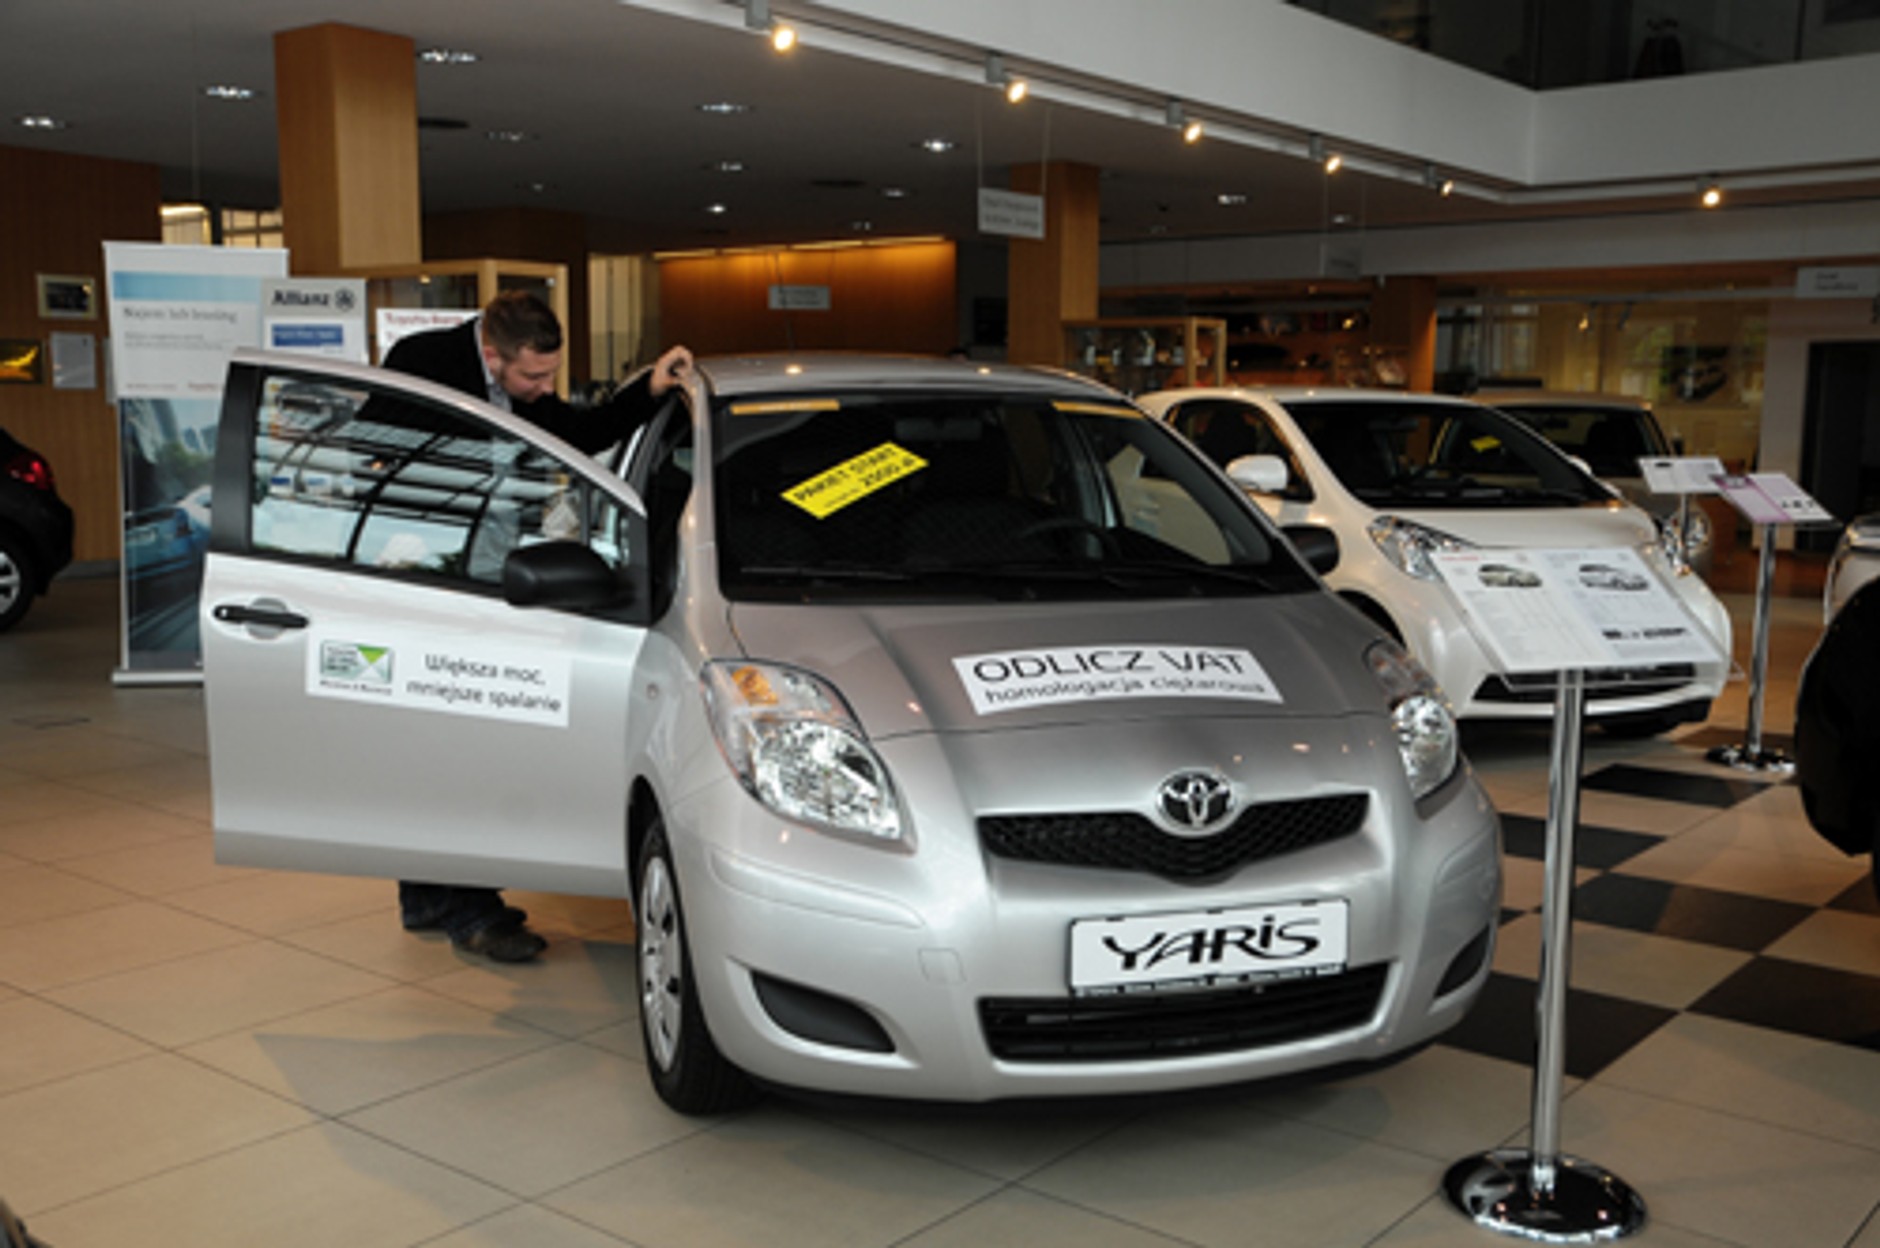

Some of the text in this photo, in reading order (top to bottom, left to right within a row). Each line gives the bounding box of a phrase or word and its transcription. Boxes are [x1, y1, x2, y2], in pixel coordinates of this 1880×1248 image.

[272, 290, 331, 306] Allianz
[793, 469, 850, 501] PAKIET
[849, 448, 896, 474] START
[425, 653, 498, 679] Większa
[973, 650, 1244, 682] ODLICZ VAT
[406, 680, 483, 703] mniejsze
[488, 688, 561, 712] spalanie
[985, 676, 1267, 705] homologacja ciężarowa
